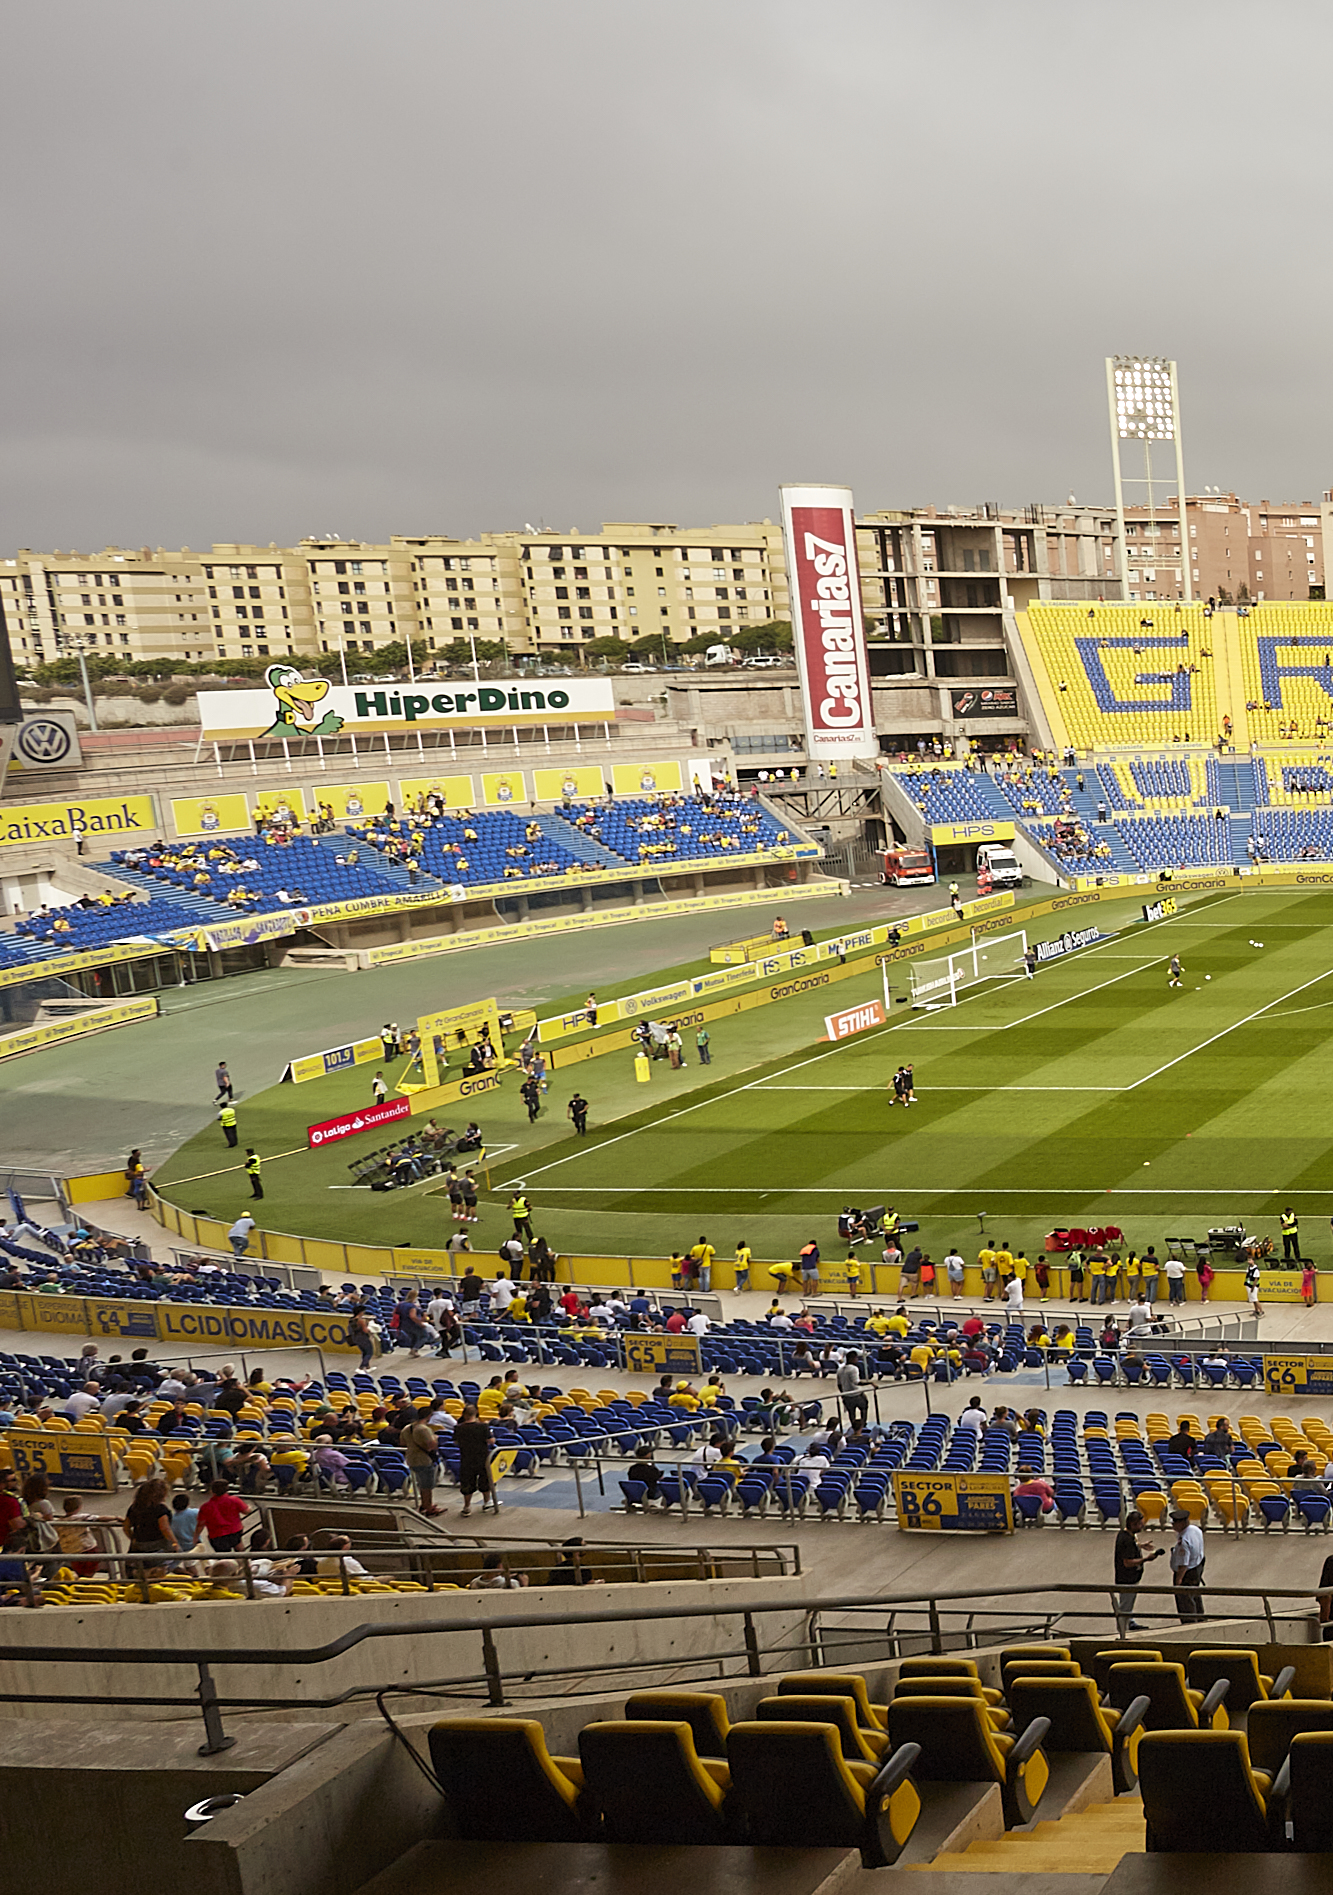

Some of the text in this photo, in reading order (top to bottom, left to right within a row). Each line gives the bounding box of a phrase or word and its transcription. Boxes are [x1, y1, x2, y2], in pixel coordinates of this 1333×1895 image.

[804, 532, 860, 728] Canarias7
[354, 688, 570, 722] HiperDino
[952, 825, 995, 840] HPS
[1156, 877, 1226, 892] GranCanaria
[345, 898, 391, 913] CUMBRE
[394, 890, 451, 905] AMARILLA
[1051, 892, 1101, 911] GranCanaria
[1144, 897, 1178, 922] bet365
[970, 914, 1012, 936] GranCanaria
[828, 934, 872, 956] MPFRE
[875, 942, 925, 964] GranCanaria
[1036, 926, 1101, 961] Allianz Seguros
[705, 975, 725, 989] Mutua
[771, 973, 830, 1000] GranCanaria
[641, 989, 688, 1009] Volkswagen
[444, 1008, 485, 1025] GranCanaria
[839, 1007, 880, 1036] STIHL
[325, 1050, 351, 1068] 101.9
[323, 1102, 409, 1140] LaLiga Santander
[97, 1311, 121, 1327] C4
[165, 1312, 352, 1345] LCIDIOMAS.CO
[629, 1339, 663, 1347] SECTOR
[628, 1346, 655, 1364] C5
[1267, 1360, 1304, 1368] SECTOR
[1266, 1367, 1296, 1385] C6
[11, 1438, 56, 1450] SECTOR
[13, 1449, 47, 1473] B5
[901, 1481, 954, 1491] SECTOR
[901, 1491, 943, 1515] B6
